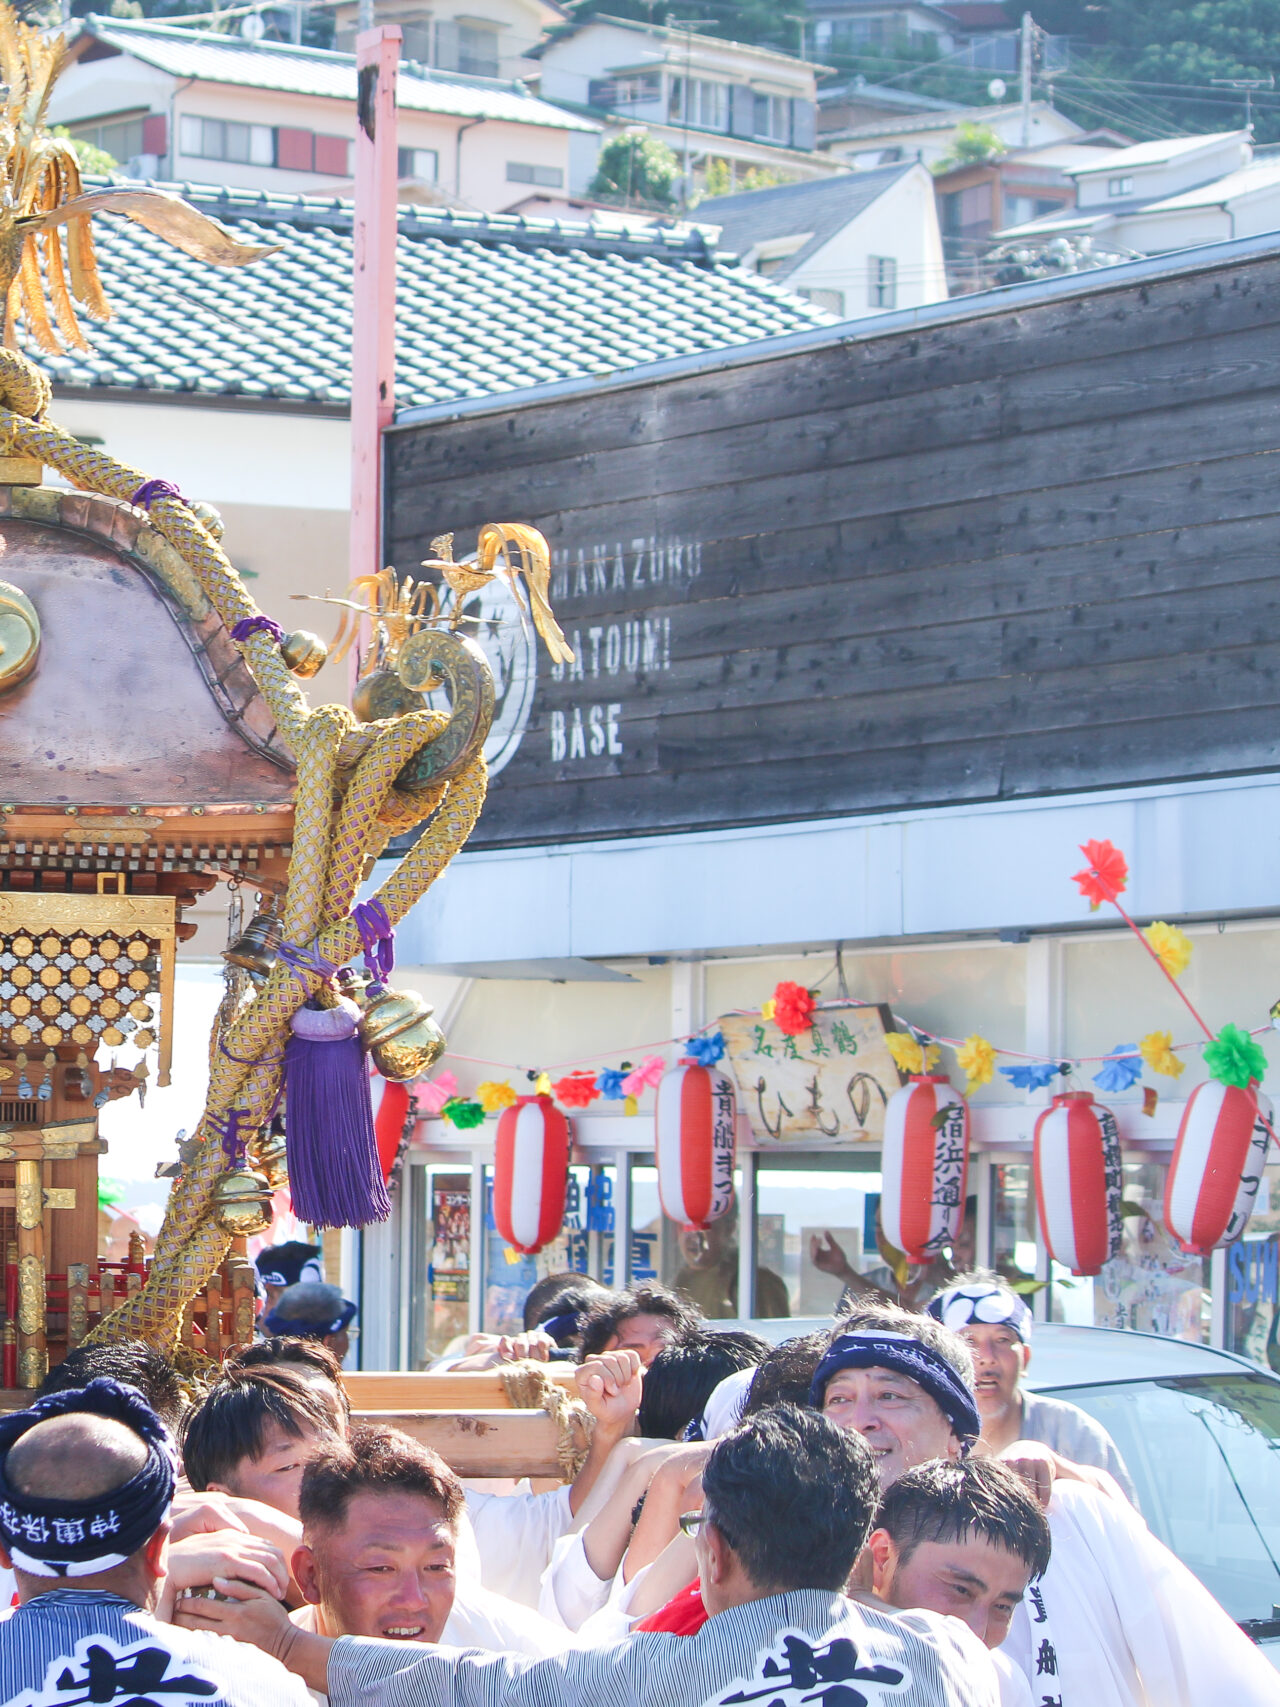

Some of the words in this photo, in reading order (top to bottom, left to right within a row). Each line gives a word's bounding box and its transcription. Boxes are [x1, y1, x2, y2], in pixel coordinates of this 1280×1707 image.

[553, 534, 702, 600] MANAZURU
[550, 703, 623, 762] BASE
[754, 1072, 888, 1139] ひもの
[711, 1079, 735, 1216] 貴船まつり
